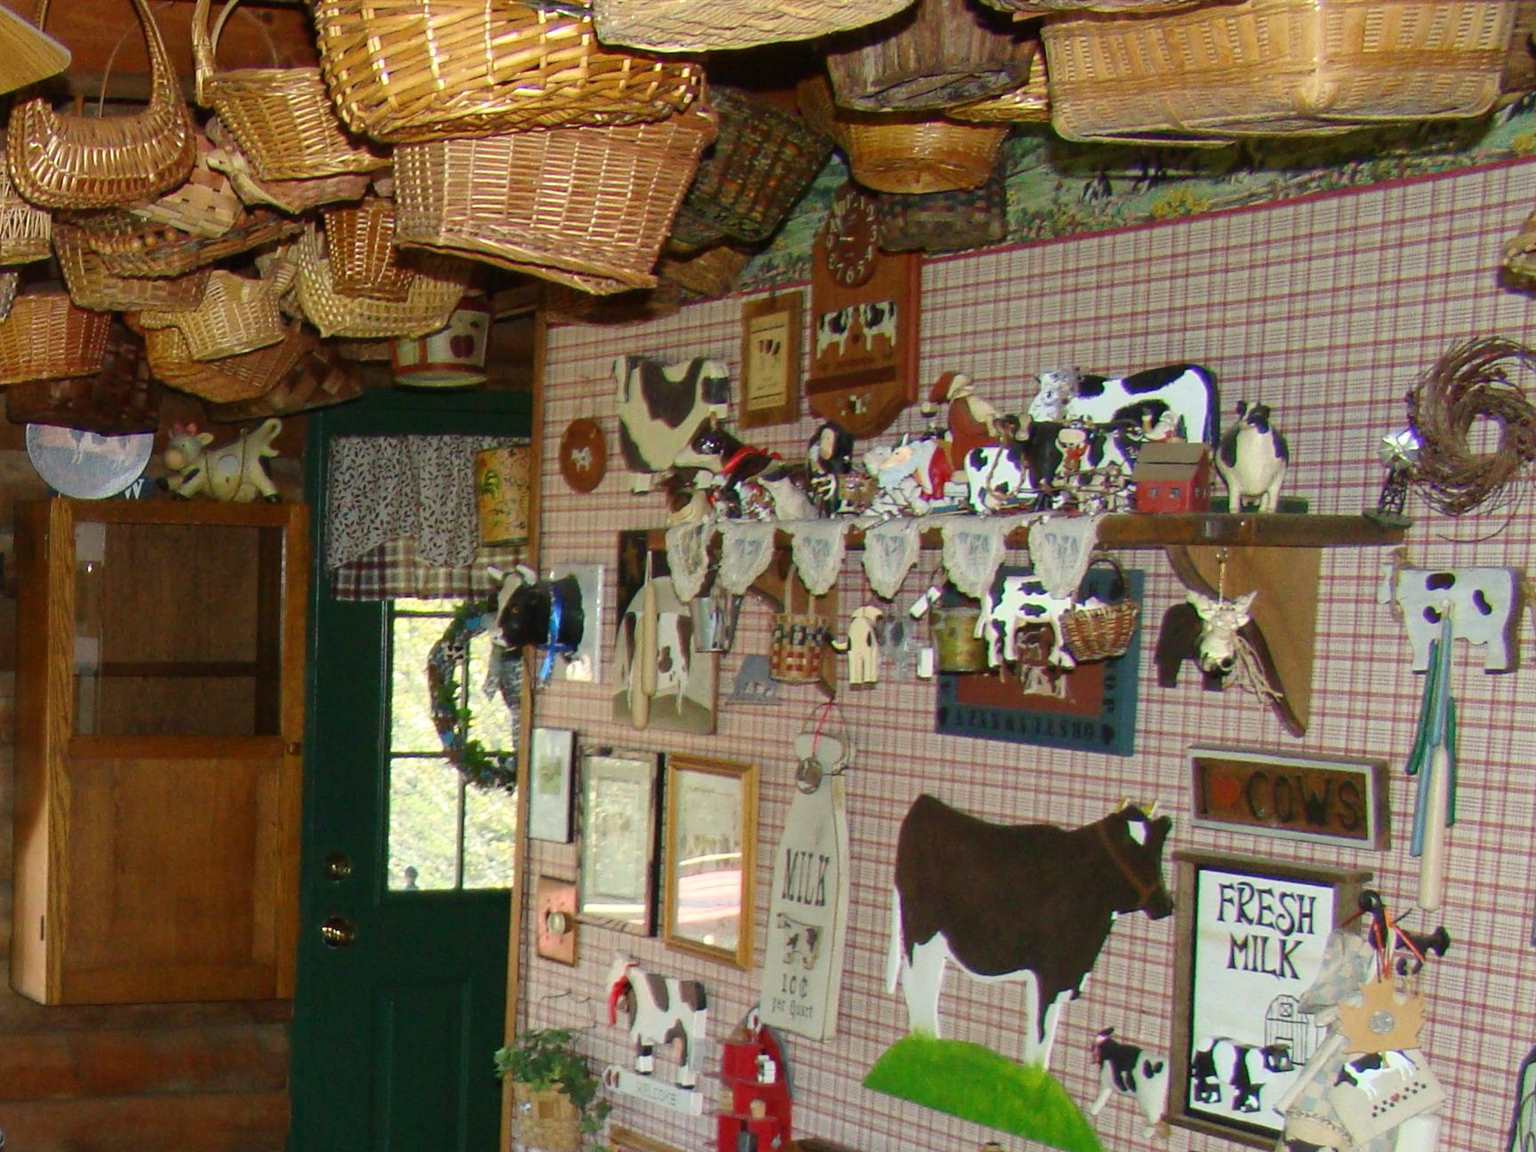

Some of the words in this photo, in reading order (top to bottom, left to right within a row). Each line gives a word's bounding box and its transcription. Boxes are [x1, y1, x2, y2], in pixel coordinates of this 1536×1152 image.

[1246, 769, 1361, 831] COWS
[782, 848, 830, 907] MILK
[1216, 880, 1317, 937] FRESH
[1226, 932, 1304, 980] MILK
